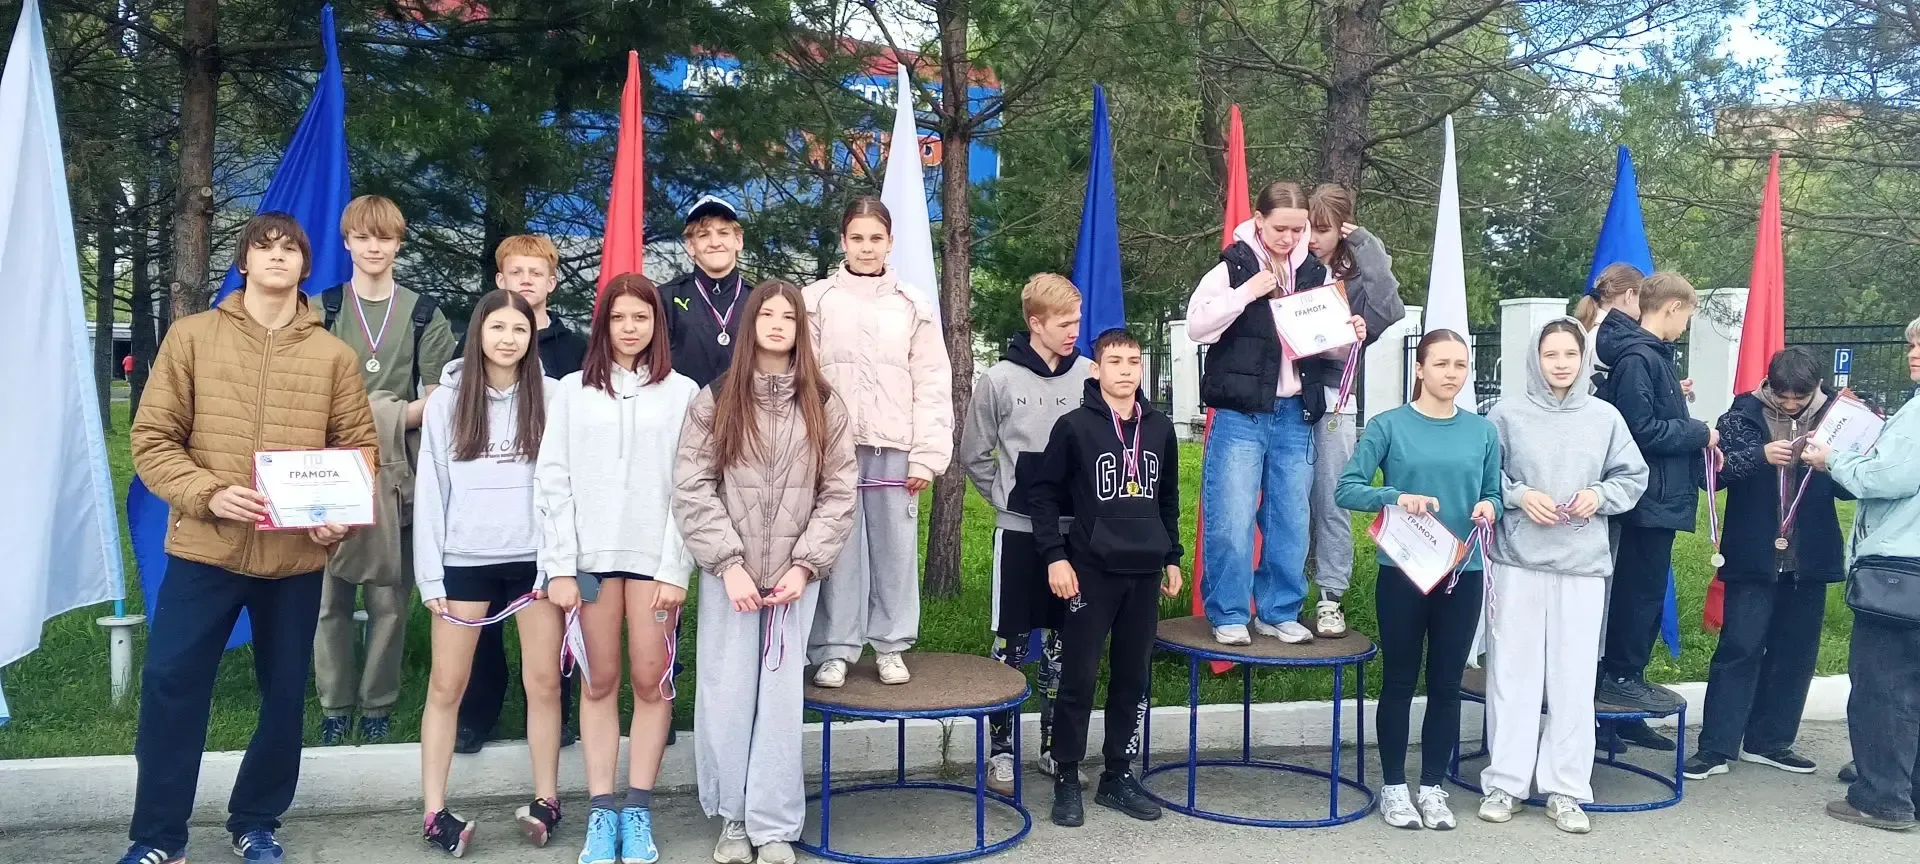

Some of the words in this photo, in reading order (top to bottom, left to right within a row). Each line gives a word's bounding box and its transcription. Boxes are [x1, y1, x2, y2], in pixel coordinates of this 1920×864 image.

[1294, 304, 1327, 317] ГРАМОТА
[1839, 352, 1849, 370] P
[1826, 417, 1848, 446] ГРАМОТА
[289, 470, 340, 479] ГРАМОТА
[1096, 448, 1159, 501] GAP
[1407, 515, 1437, 546] ГРАМОТА
